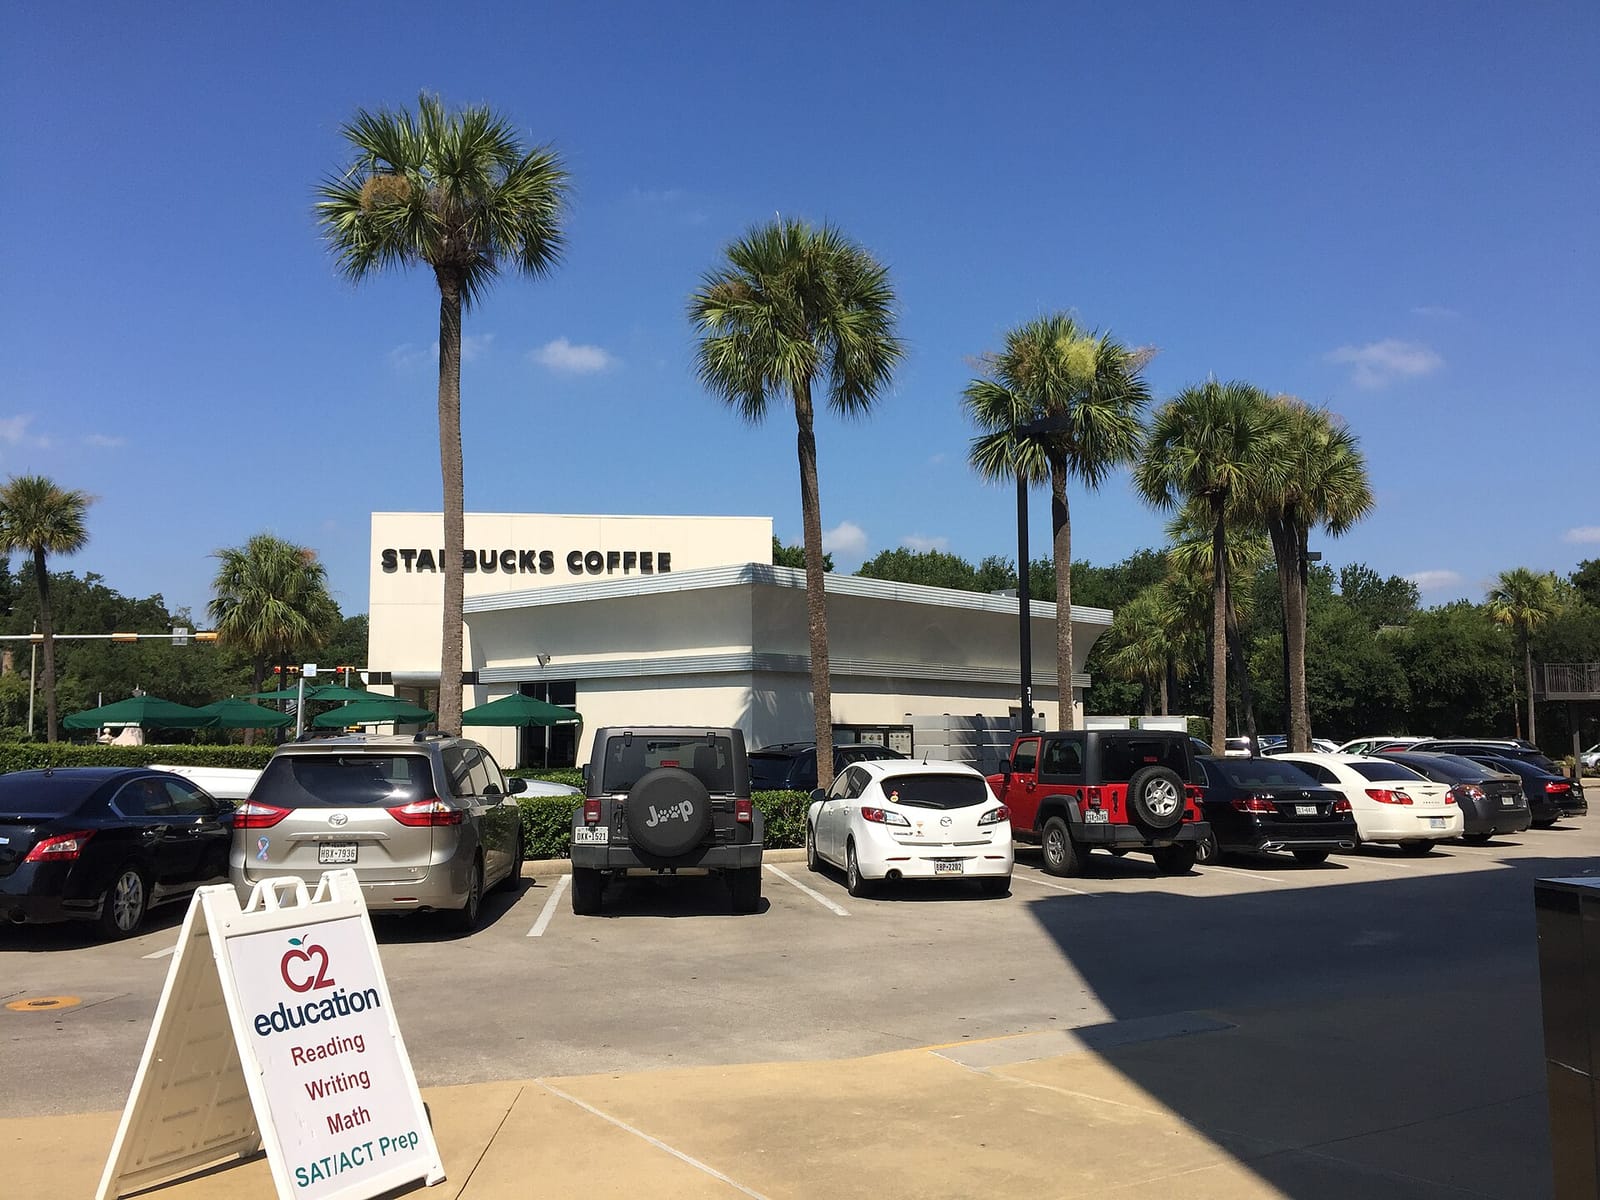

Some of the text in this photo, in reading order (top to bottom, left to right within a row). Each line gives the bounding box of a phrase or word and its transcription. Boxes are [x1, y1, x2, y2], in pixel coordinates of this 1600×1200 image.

[381, 549, 671, 575] STABUCKS COFFEE
[281, 944, 336, 993] C2
[254, 987, 381, 1037] education
[291, 1034, 365, 1066] Reading
[305, 1070, 371, 1101] Writing
[326, 1106, 371, 1135] Math
[295, 1130, 418, 1187] SAT/ACT Prep
